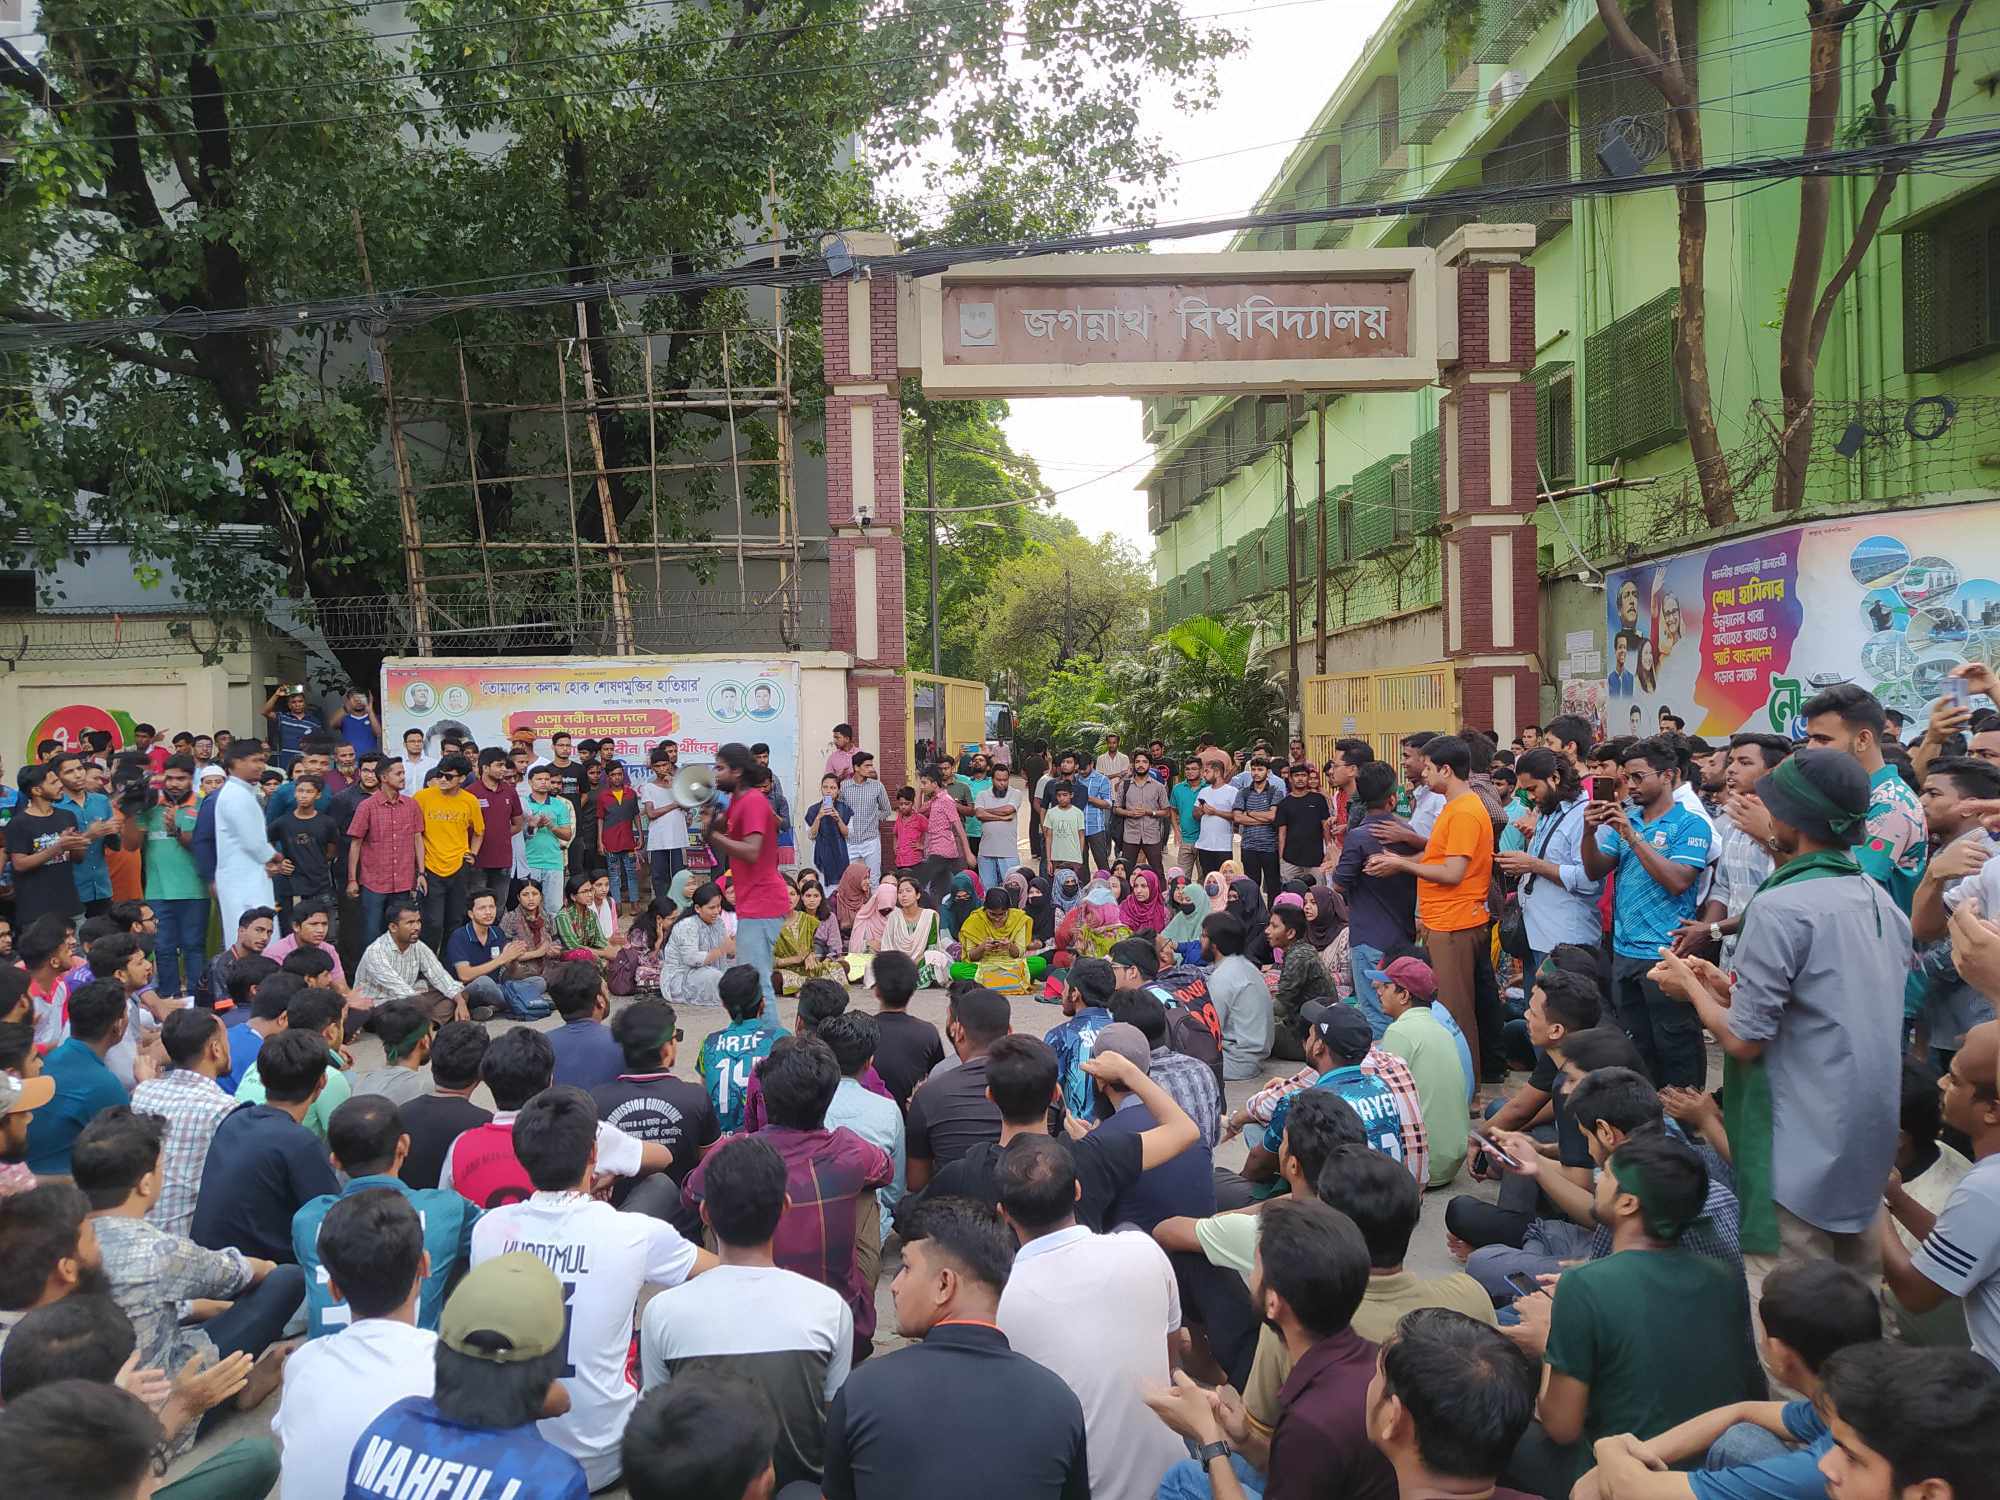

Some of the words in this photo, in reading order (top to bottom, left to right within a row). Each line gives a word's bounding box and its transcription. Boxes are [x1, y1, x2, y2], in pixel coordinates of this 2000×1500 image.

[1020, 304, 1152, 344] জগন্নাথ
[1175, 295, 1390, 342] বিশ্ববিদ্যালয়
[1712, 587, 1735, 613] শেখ
[1738, 576, 1785, 605] হাসিনার
[1712, 612, 1745, 632] উন্নয়নের
[1744, 627, 1768, 642] রাখতে
[1769, 626, 1777, 641] ও
[1732, 646, 1773, 664] বাংলাদেশ
[536, 682, 560, 694] কলম
[565, 681, 590, 695] হোক
[594, 676, 652, 696] শোষণমুক্তির
[535, 714, 561, 724] এসো
[564, 711, 594, 724] নবীন
[596, 713, 621, 723] দলে
[624, 713, 648, 723] দলে
[589, 726, 627, 737] পতাকা
[629, 725, 656, 736] তলে
[716, 1031, 766, 1052] ARIF
[606, 1098, 644, 1126] DMISSION
[645, 1097, 684, 1124] GUIDELINE
